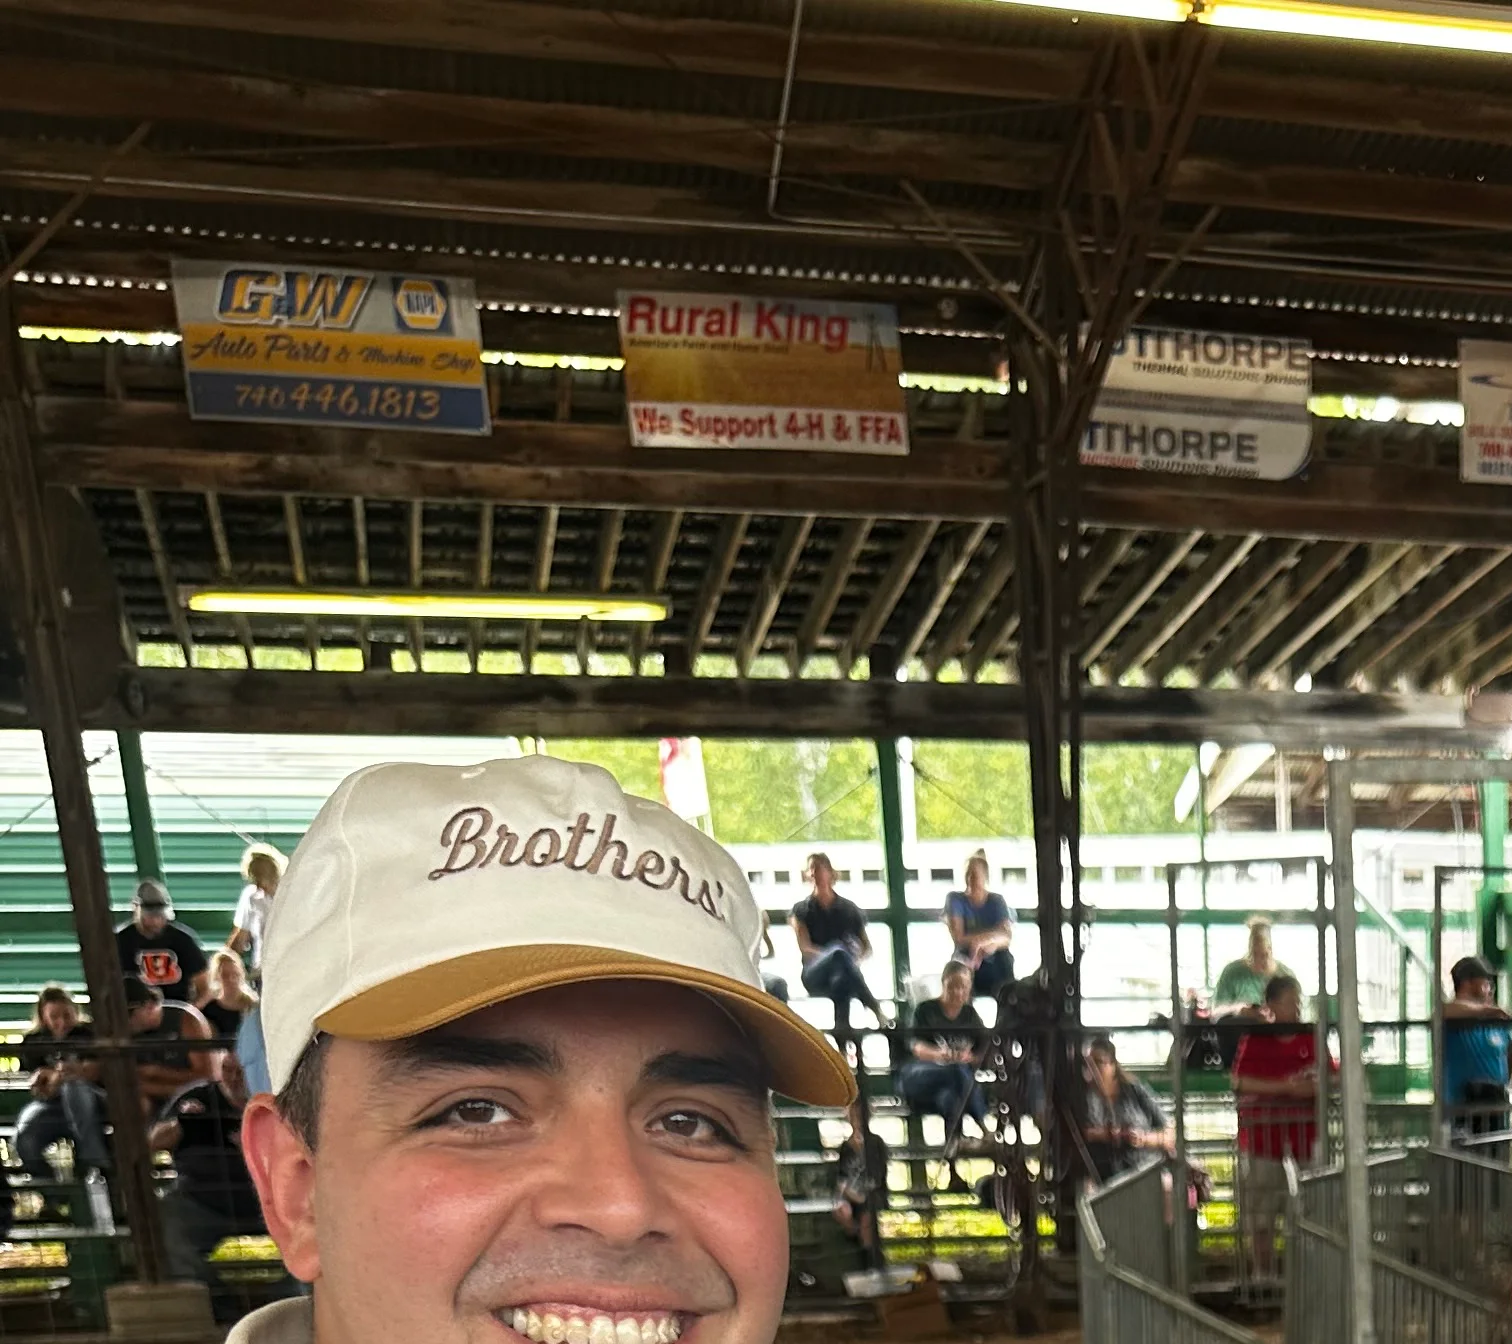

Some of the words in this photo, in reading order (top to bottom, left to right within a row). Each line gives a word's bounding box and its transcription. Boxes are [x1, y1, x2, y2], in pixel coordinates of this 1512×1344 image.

[627, 295, 741, 337] Rural
[756, 303, 850, 354] King
[188, 331, 257, 363] Auto
[1111, 327, 1310, 371] TTHORPE
[633, 407, 673, 435] We
[680, 407, 779, 442] Support
[785, 412, 825, 441] 4-H
[833, 415, 851, 442] &
[857, 414, 902, 446] FFA
[1086, 420, 1260, 463] TTHORPE
